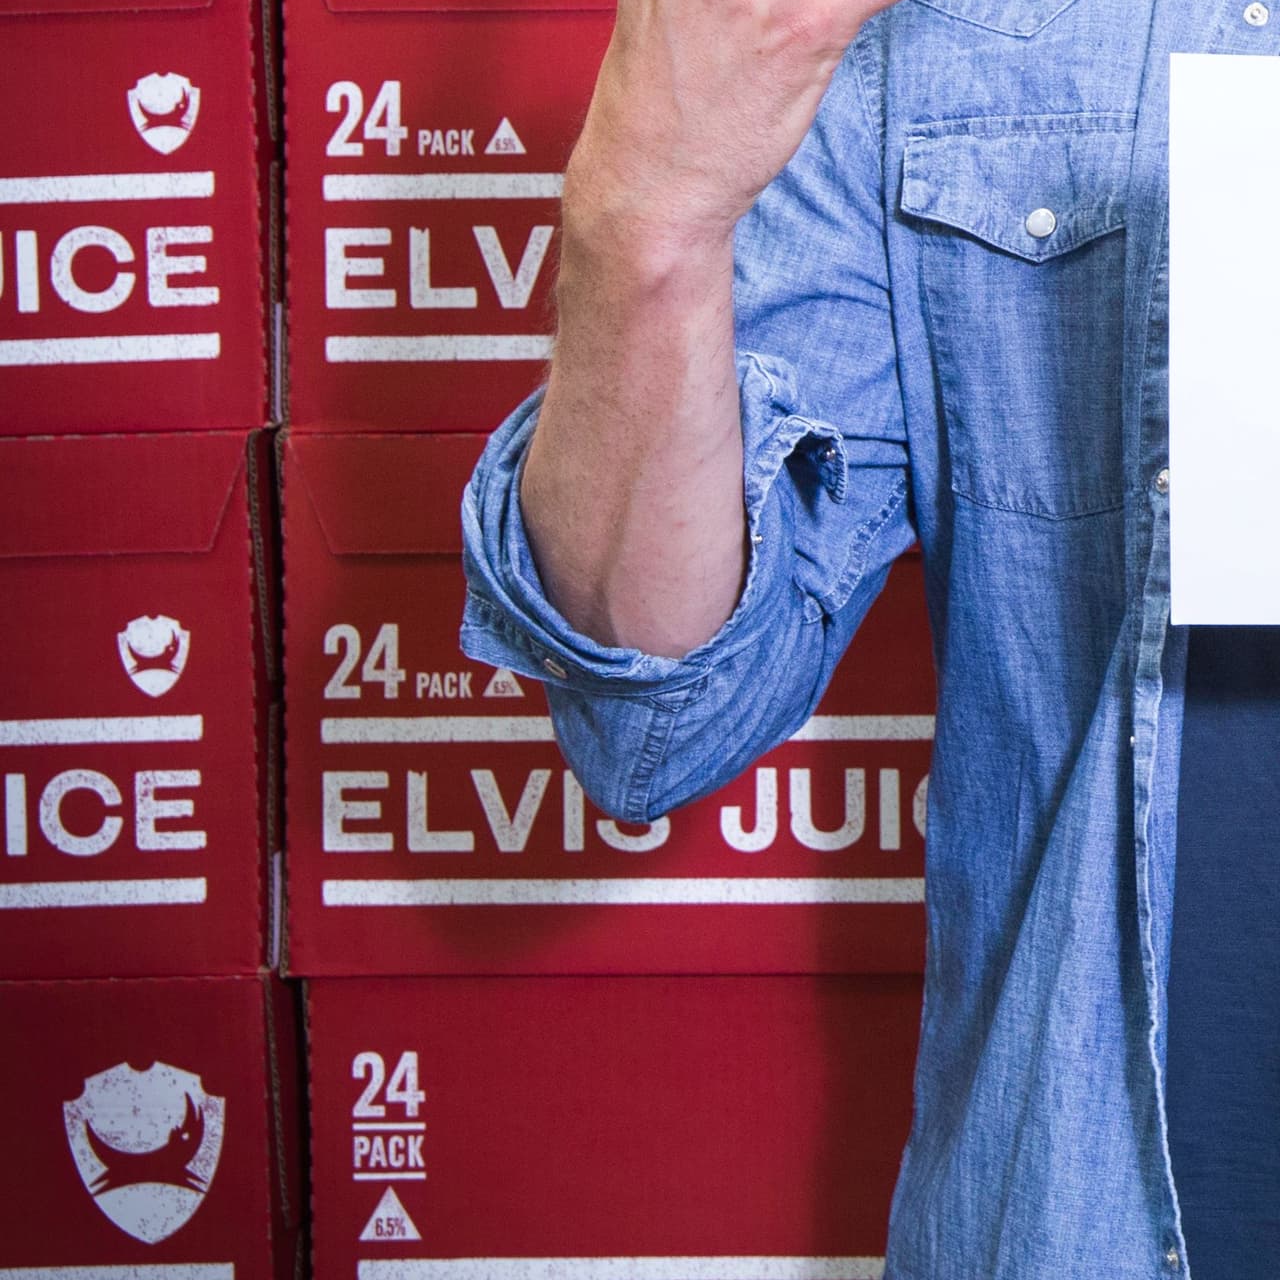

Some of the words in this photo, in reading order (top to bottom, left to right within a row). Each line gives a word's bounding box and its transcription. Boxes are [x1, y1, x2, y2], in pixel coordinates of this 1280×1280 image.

[327, 81, 407, 156] 24
[419, 130, 474, 155] PACK
[0, 226, 219, 312] ICE
[325, 624, 406, 698] 24
[417, 672, 472, 698] PACK
[6, 769, 207, 855] ICE
[720, 767, 929, 852] JUI
[353, 1051, 425, 1117] 24
[354, 1136, 424, 1167] PACK
[374, 1217, 407, 1237] 6.5%
